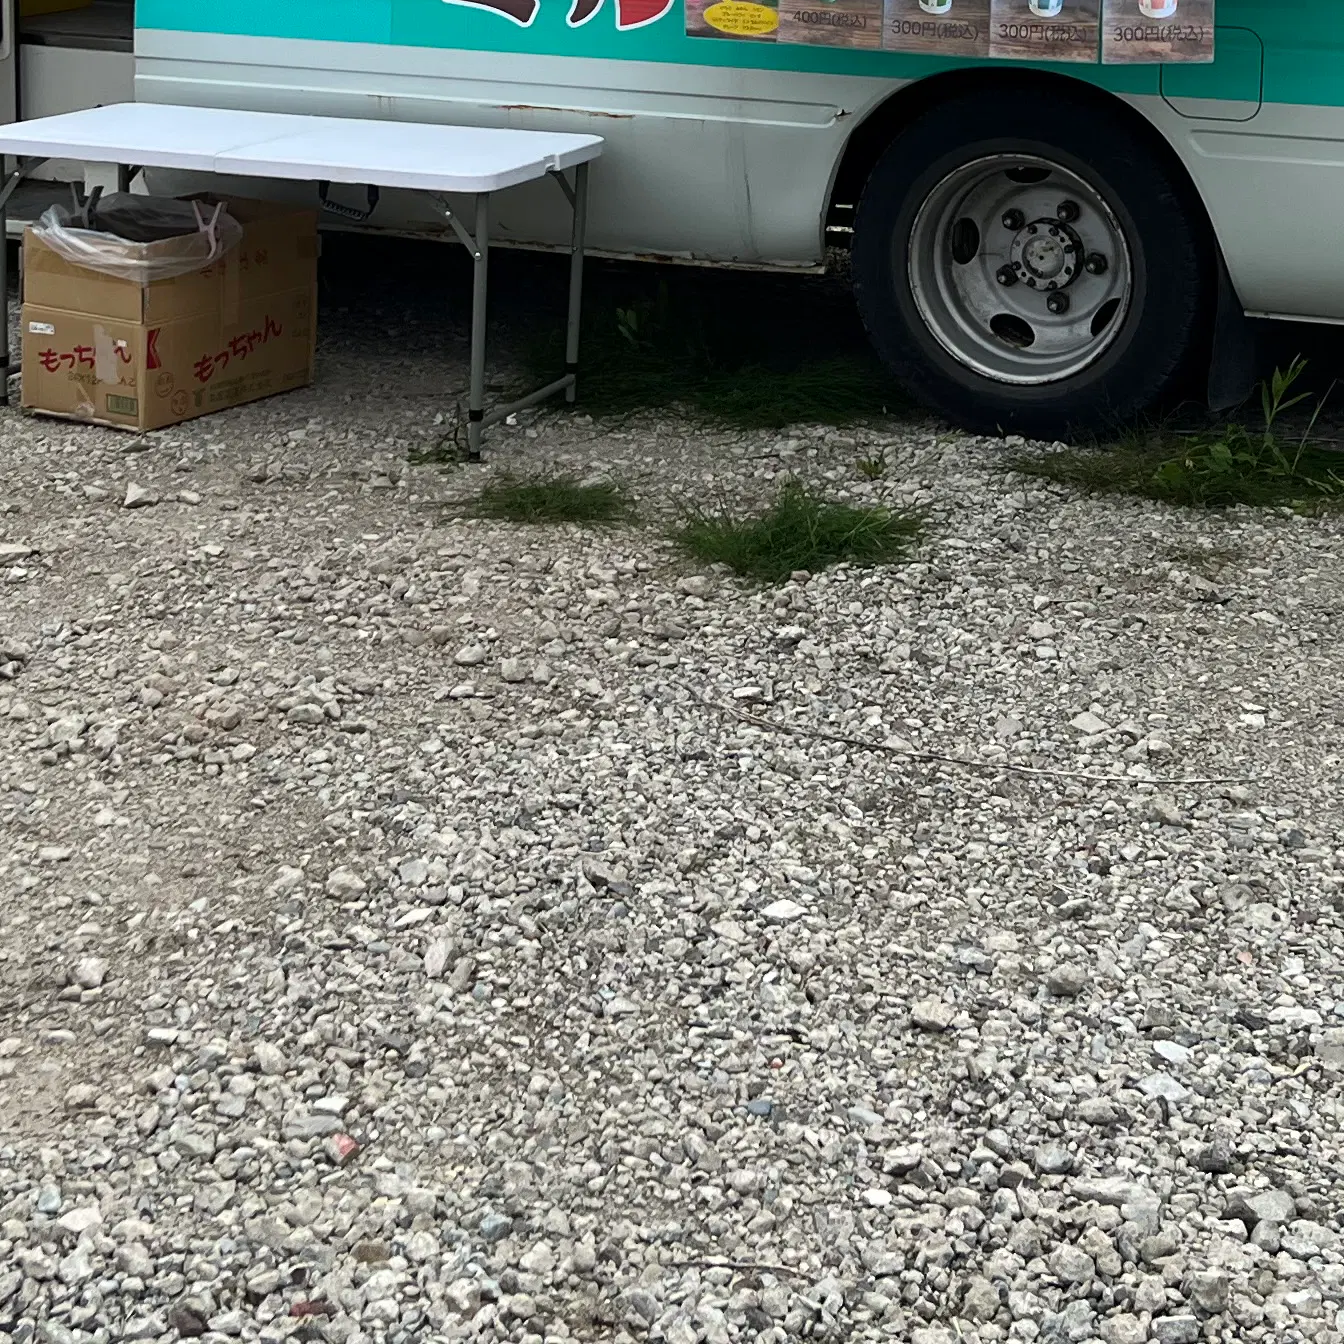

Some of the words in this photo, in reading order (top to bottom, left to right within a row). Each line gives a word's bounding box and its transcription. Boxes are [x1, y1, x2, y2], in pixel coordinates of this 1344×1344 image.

[792, 10, 867, 29] 400円(税込)
[891, 19, 980, 41] 300円(税込)
[998, 23, 1087, 43] 300円(税込)
[1112, 25, 1205, 43] 300円(税込)
[193, 314, 283, 383] もっちゃん
